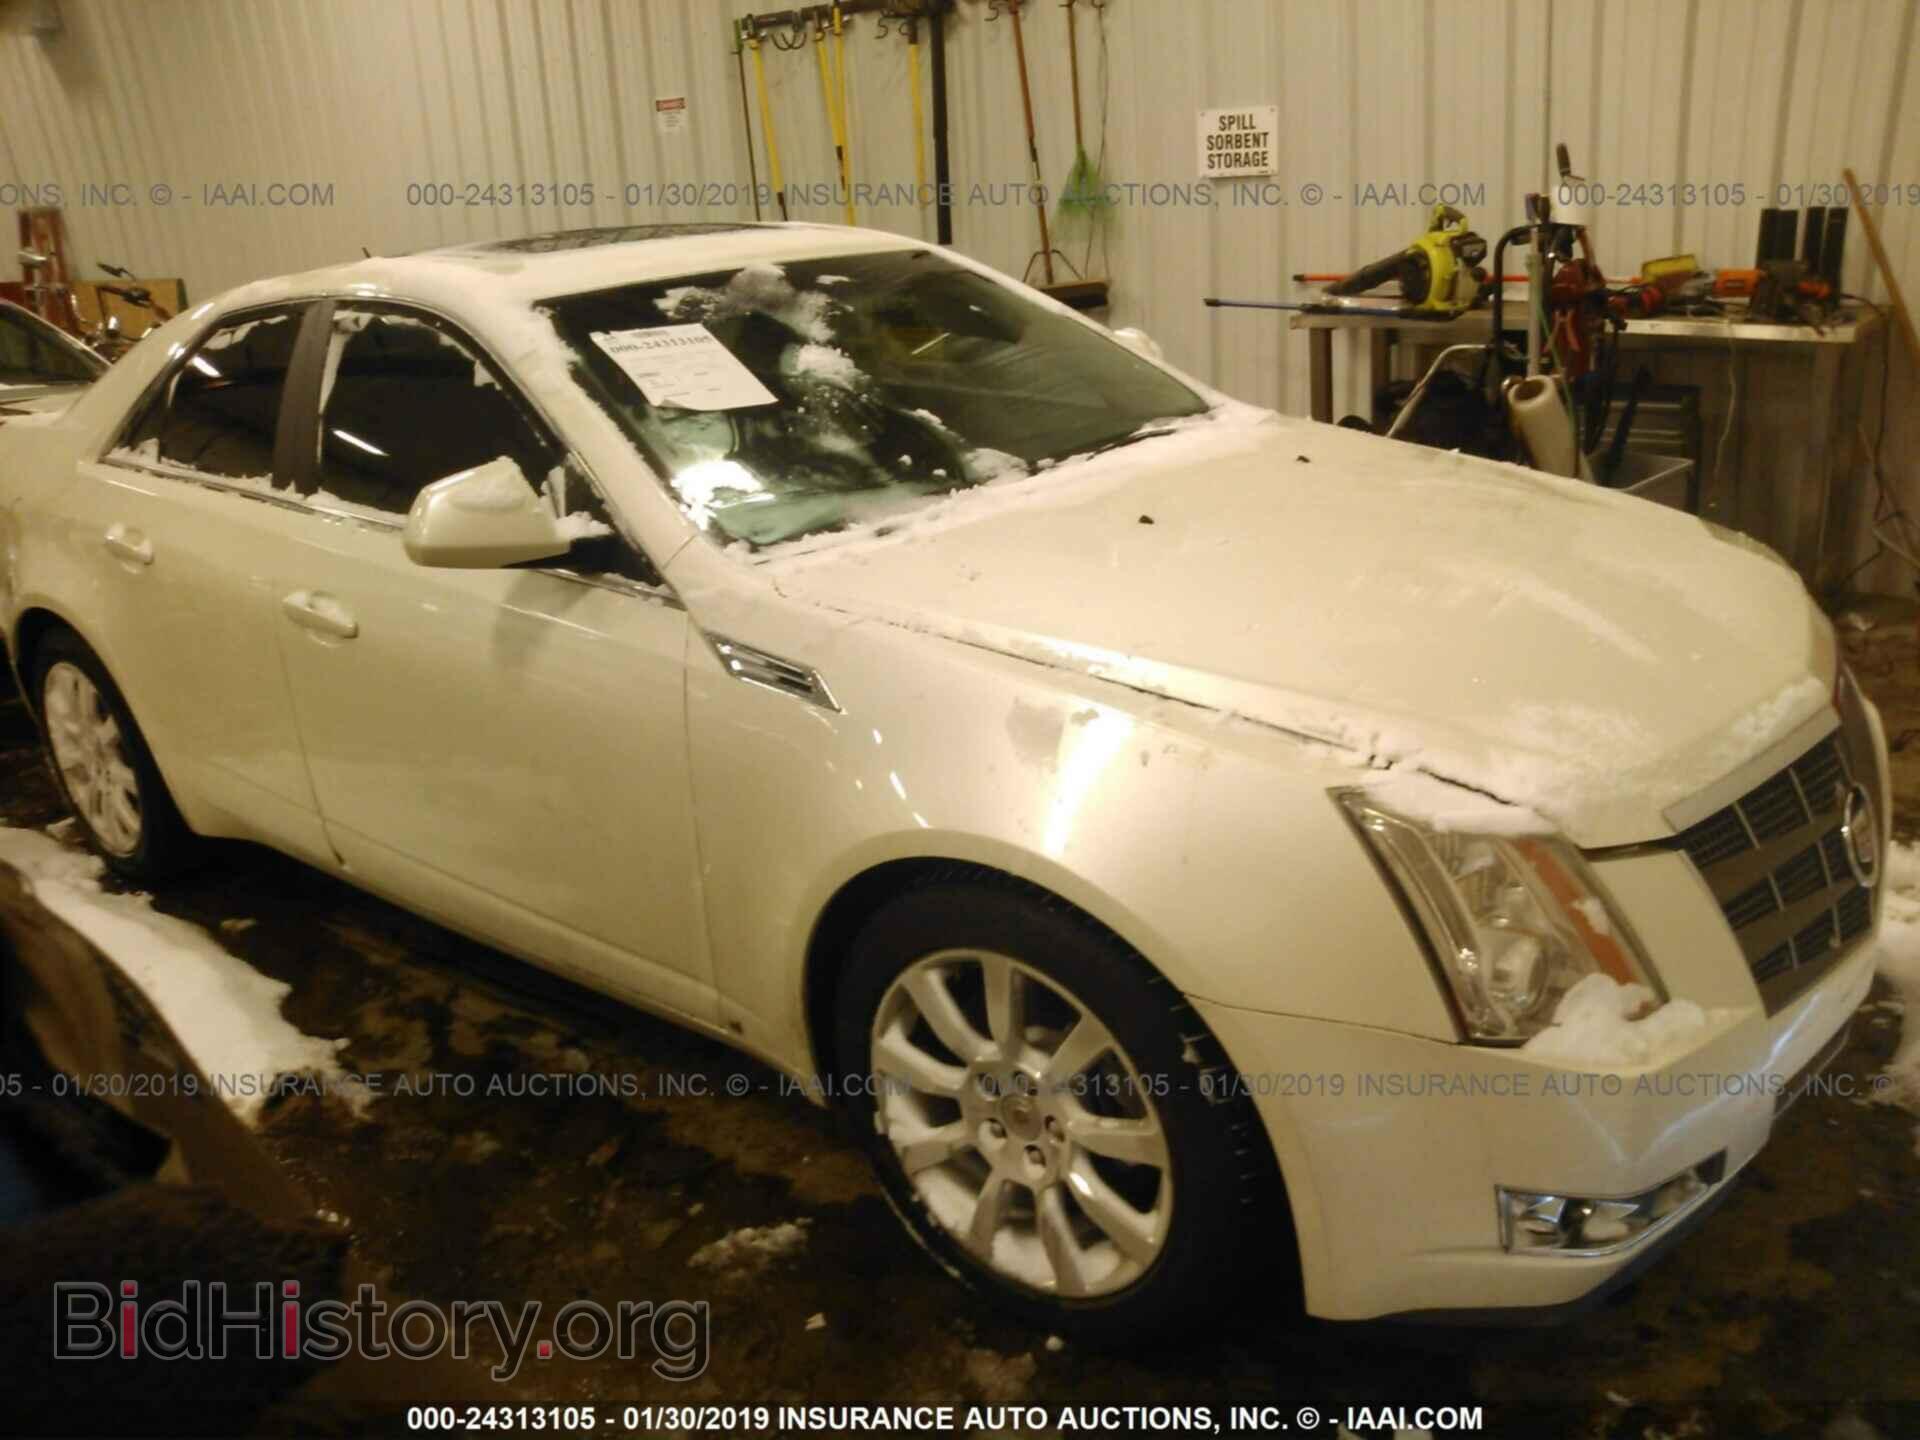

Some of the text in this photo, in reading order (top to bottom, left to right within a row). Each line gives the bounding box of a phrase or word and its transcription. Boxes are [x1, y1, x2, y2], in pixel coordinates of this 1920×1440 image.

[1218, 113, 1256, 131] SPILL
[1206, 132, 1269, 151] SORBENT
[1207, 151, 1268, 169] STORAGE
